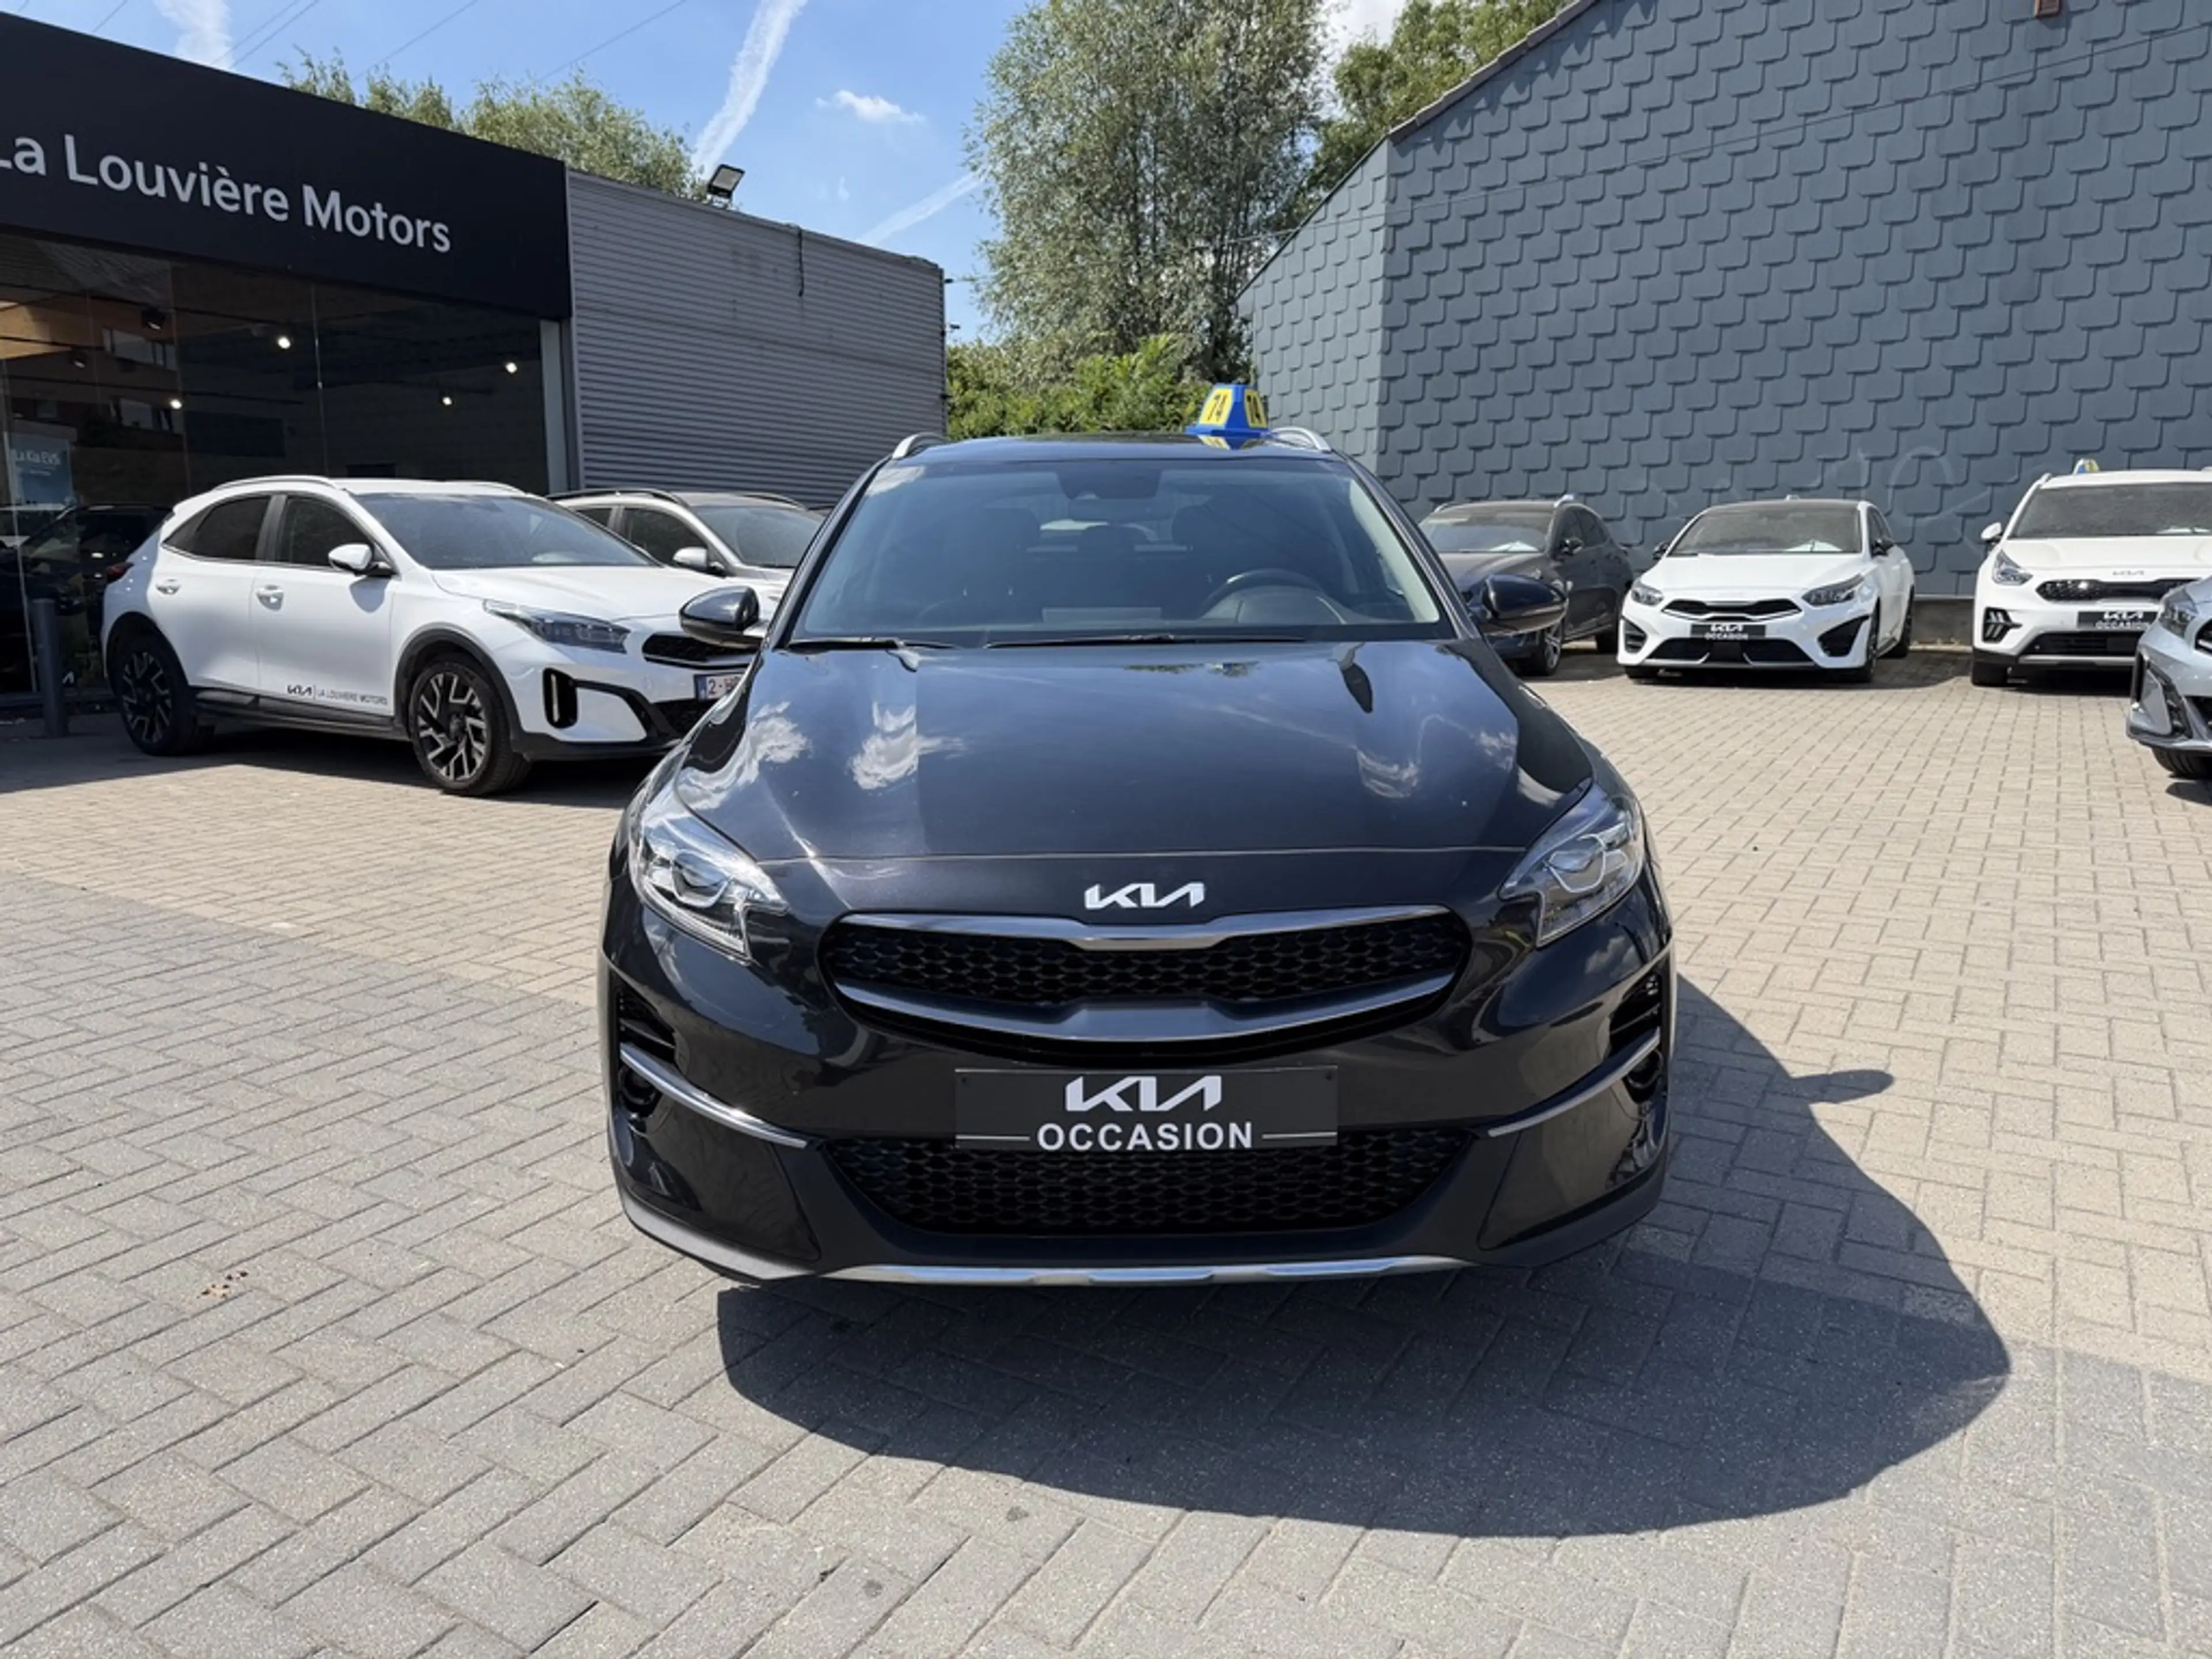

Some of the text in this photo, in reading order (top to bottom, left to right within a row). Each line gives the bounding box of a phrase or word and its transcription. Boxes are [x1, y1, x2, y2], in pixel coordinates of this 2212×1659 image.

[64, 134, 289, 221] Louvière
[302, 184, 451, 252] Motors
[1084, 881, 1205, 910] KIA
[1065, 1075, 1222, 1112] KIA
[1037, 1122, 1252, 1152] OCCASION
